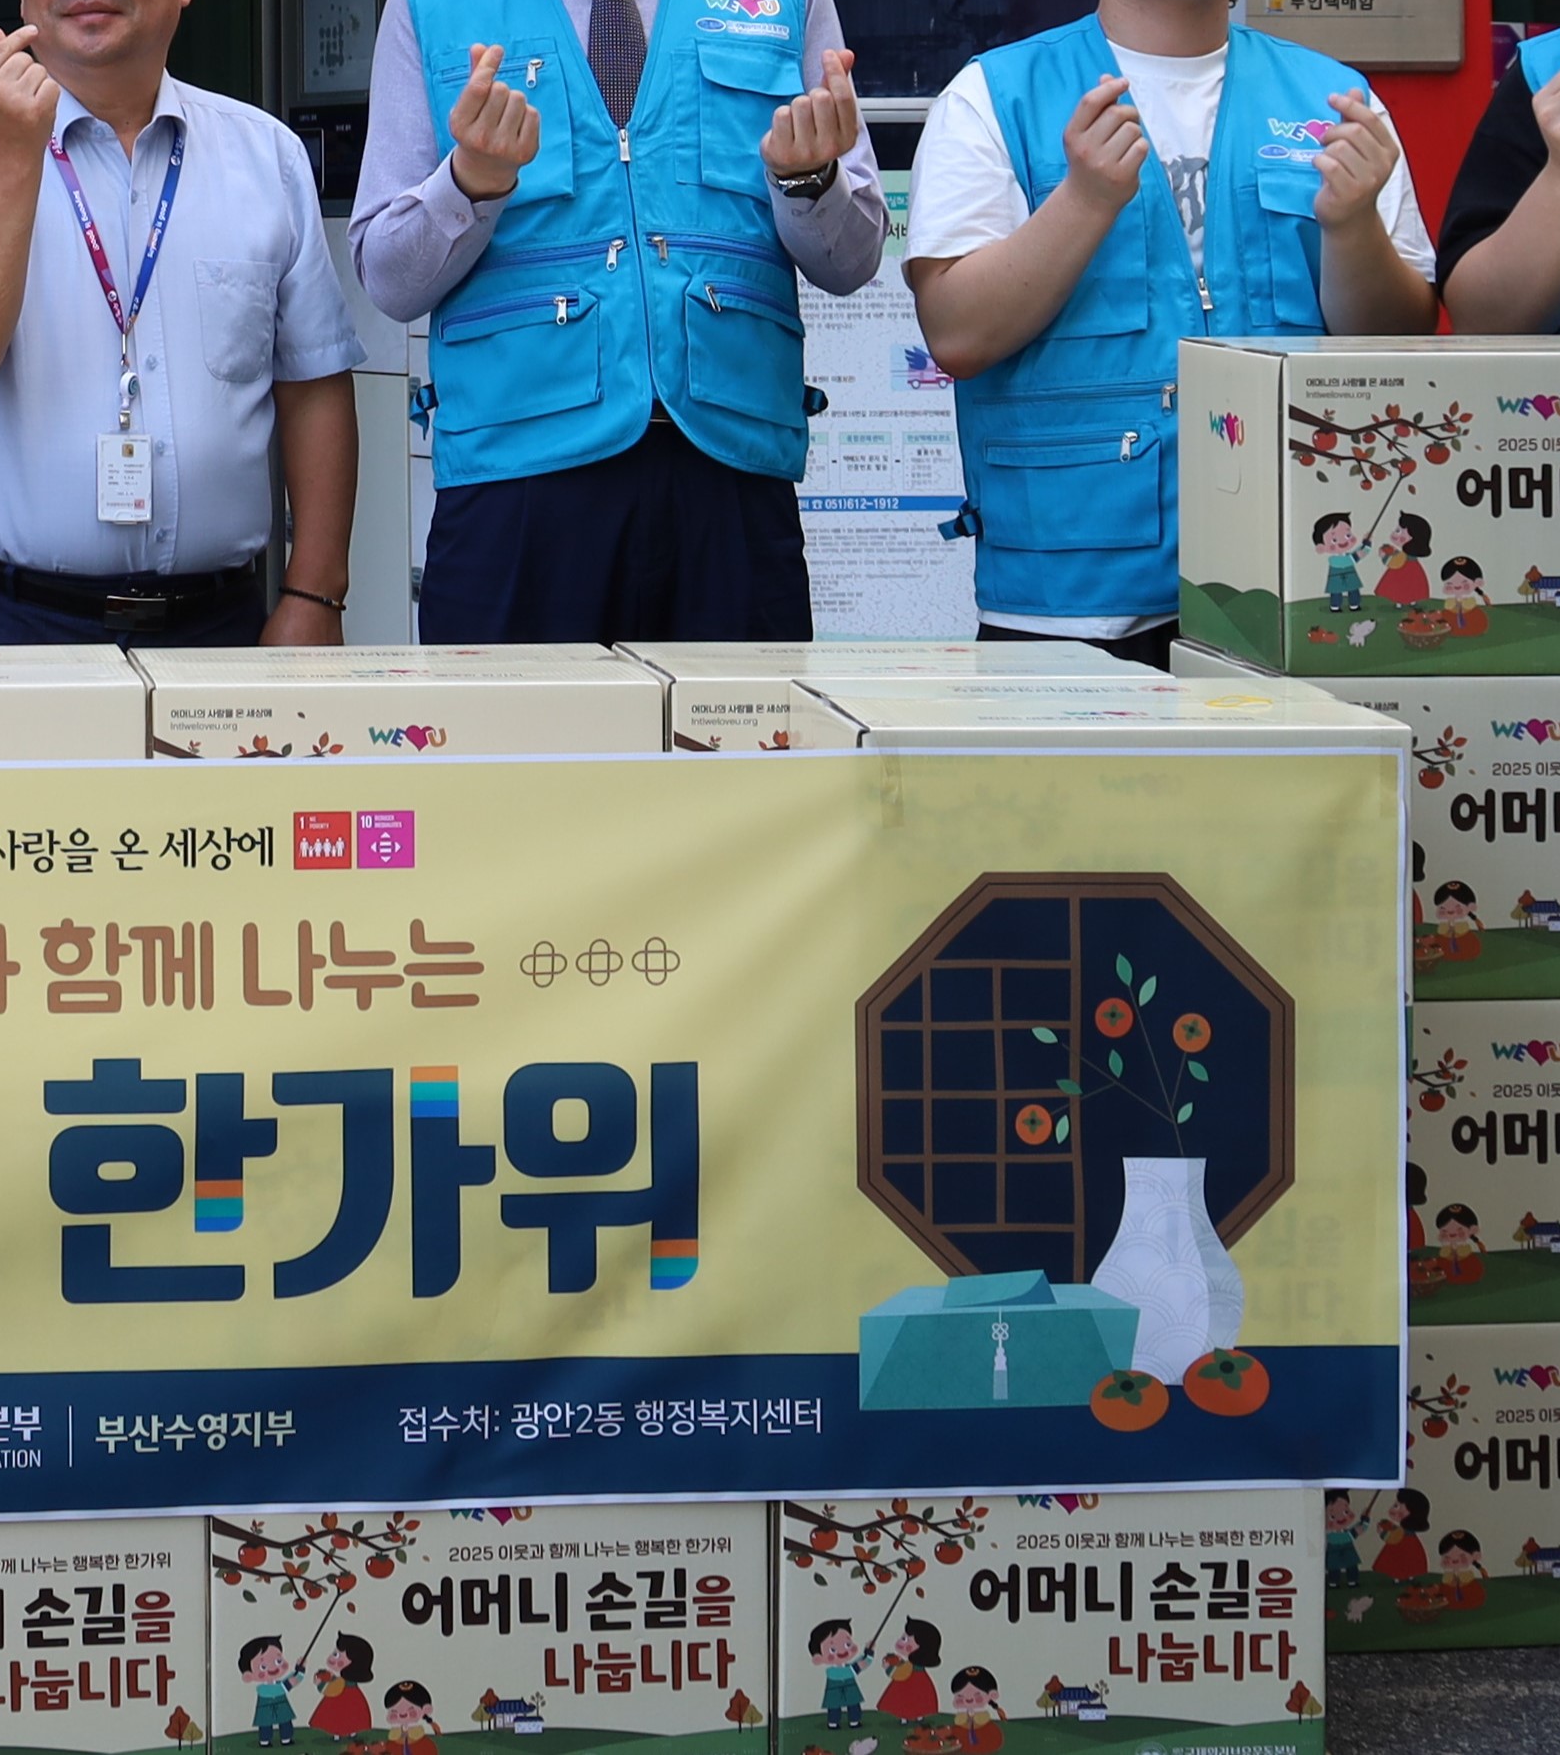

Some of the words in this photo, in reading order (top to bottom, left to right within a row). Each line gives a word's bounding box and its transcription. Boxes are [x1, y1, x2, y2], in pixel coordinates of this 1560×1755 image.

[825, 497, 899, 510] 051)612-1912
[360, 815, 372, 829] 10
[110, 829, 151, 870] 온
[159, 824, 274, 871] 세상에
[39, 917, 214, 1018] 함께
[242, 917, 484, 1011] 나누는
[42, 1056, 701, 1307] 한가위
[95, 1410, 297, 1455] 부산수영지부
[396, 1404, 502, 1443] 접수처:
[510, 1401, 626, 1441] 광안2동
[633, 1397, 824, 1438] 행정복지센터
[968, 1561, 1135, 1628] 어머니
[1148, 1558, 1298, 1624] 손길을
[1106, 1629, 1297, 1686] 나눕니다
